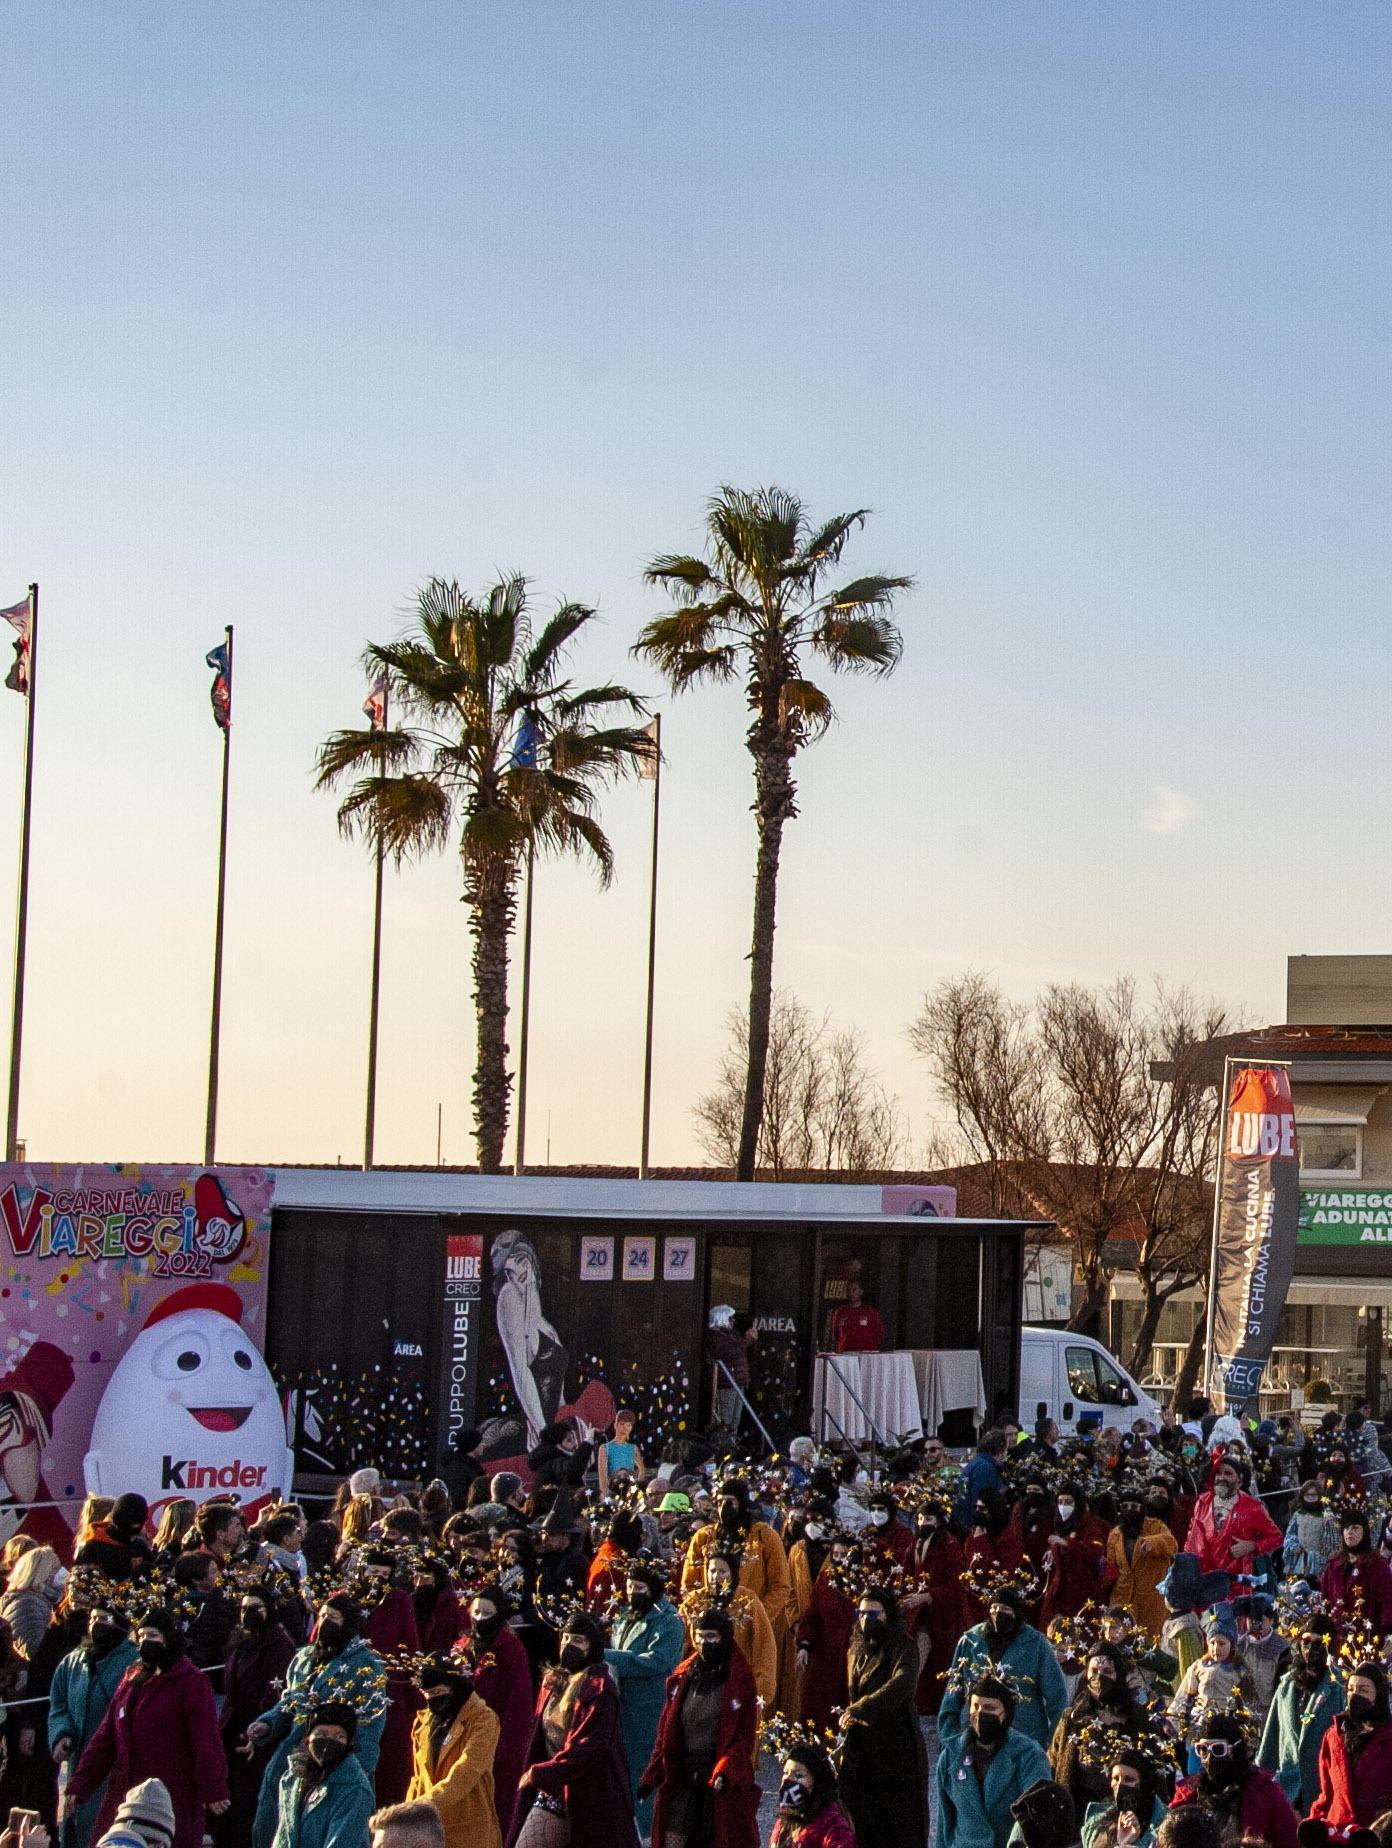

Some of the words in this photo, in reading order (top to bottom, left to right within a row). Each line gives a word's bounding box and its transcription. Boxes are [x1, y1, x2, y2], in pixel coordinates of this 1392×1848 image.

[1230, 1111, 1295, 1157] LUBE
[53, 1187, 184, 1217] CARNEVALE
[1245, 1168, 1260, 1243] CUCINA
[154, 1250, 213, 1277] 2022
[446, 1256, 482, 1279] LUBE
[587, 1250, 608, 1266] 20
[628, 1250, 649, 1267] 24
[670, 1250, 689, 1266] 27
[446, 1282, 480, 1295] CREO
[1250, 1243, 1271, 1316] CHIAMA
[1248, 1320, 1262, 1336] SI
[394, 1344, 423, 1356] AREA
